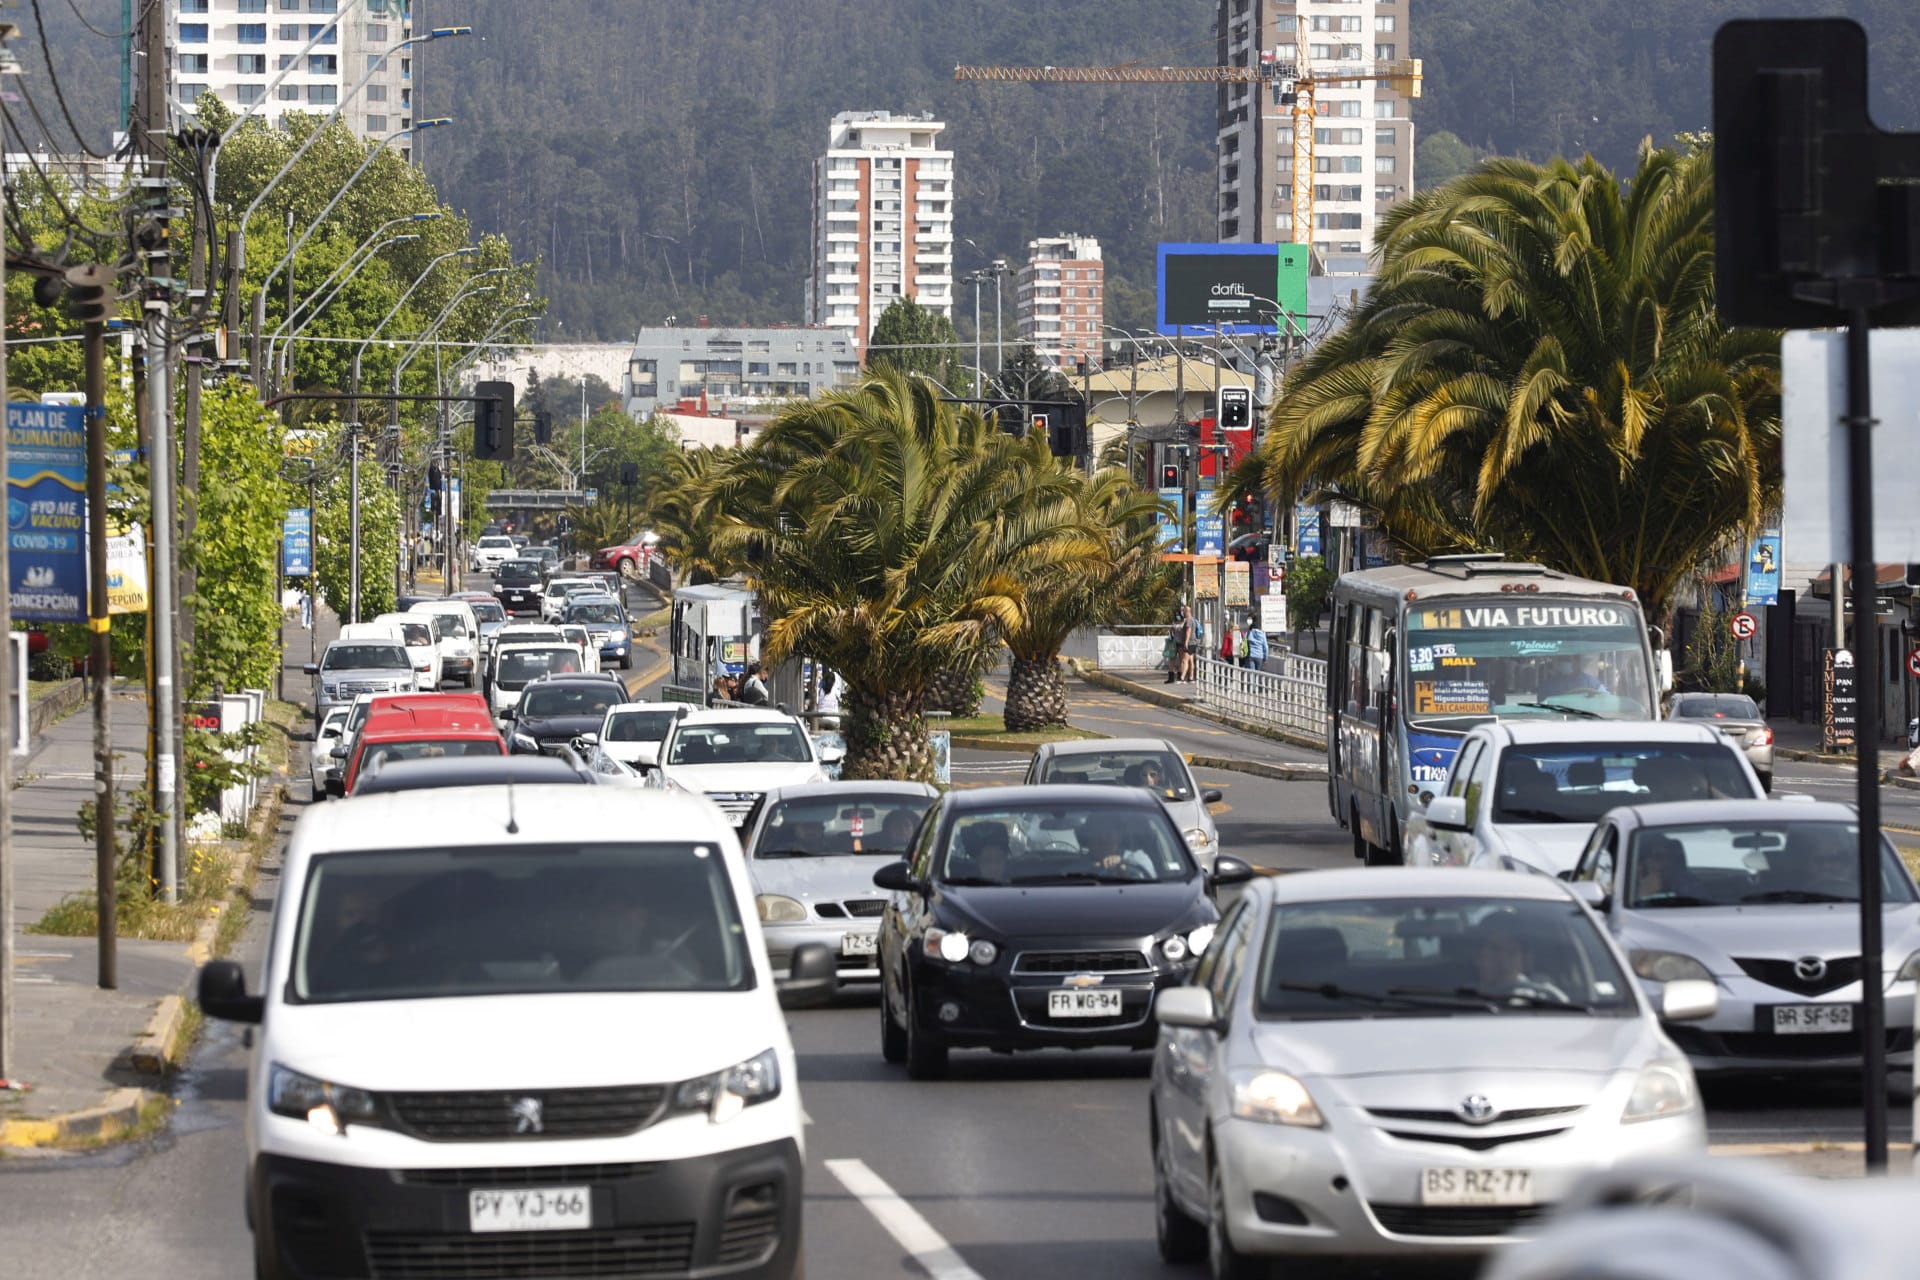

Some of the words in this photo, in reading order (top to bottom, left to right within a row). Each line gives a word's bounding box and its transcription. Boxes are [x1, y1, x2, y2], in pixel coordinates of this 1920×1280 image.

[1211, 283, 1245, 296] dafiti
[8, 409, 45, 427] PLAN
[48, 411, 66, 428] DE
[57, 501, 77, 516] ME
[31, 514, 81, 529] VACUNO
[13, 534, 67, 549] COVID-19
[1464, 608, 1510, 627] VIA
[1517, 607, 1617, 626] FUTURO
[1739, 618, 1750, 634] E
[1442, 657, 1476, 667] MALL
[1824, 650, 1834, 745] ALMUERZOS
[1435, 703, 1489, 713] TALCAHUANO
[1412, 765, 1431, 780] 11
[1051, 994, 1070, 1008] FR
[1776, 1008, 1798, 1025] BR
[1427, 1169, 1455, 1193] BS
[475, 1194, 502, 1217] PY
